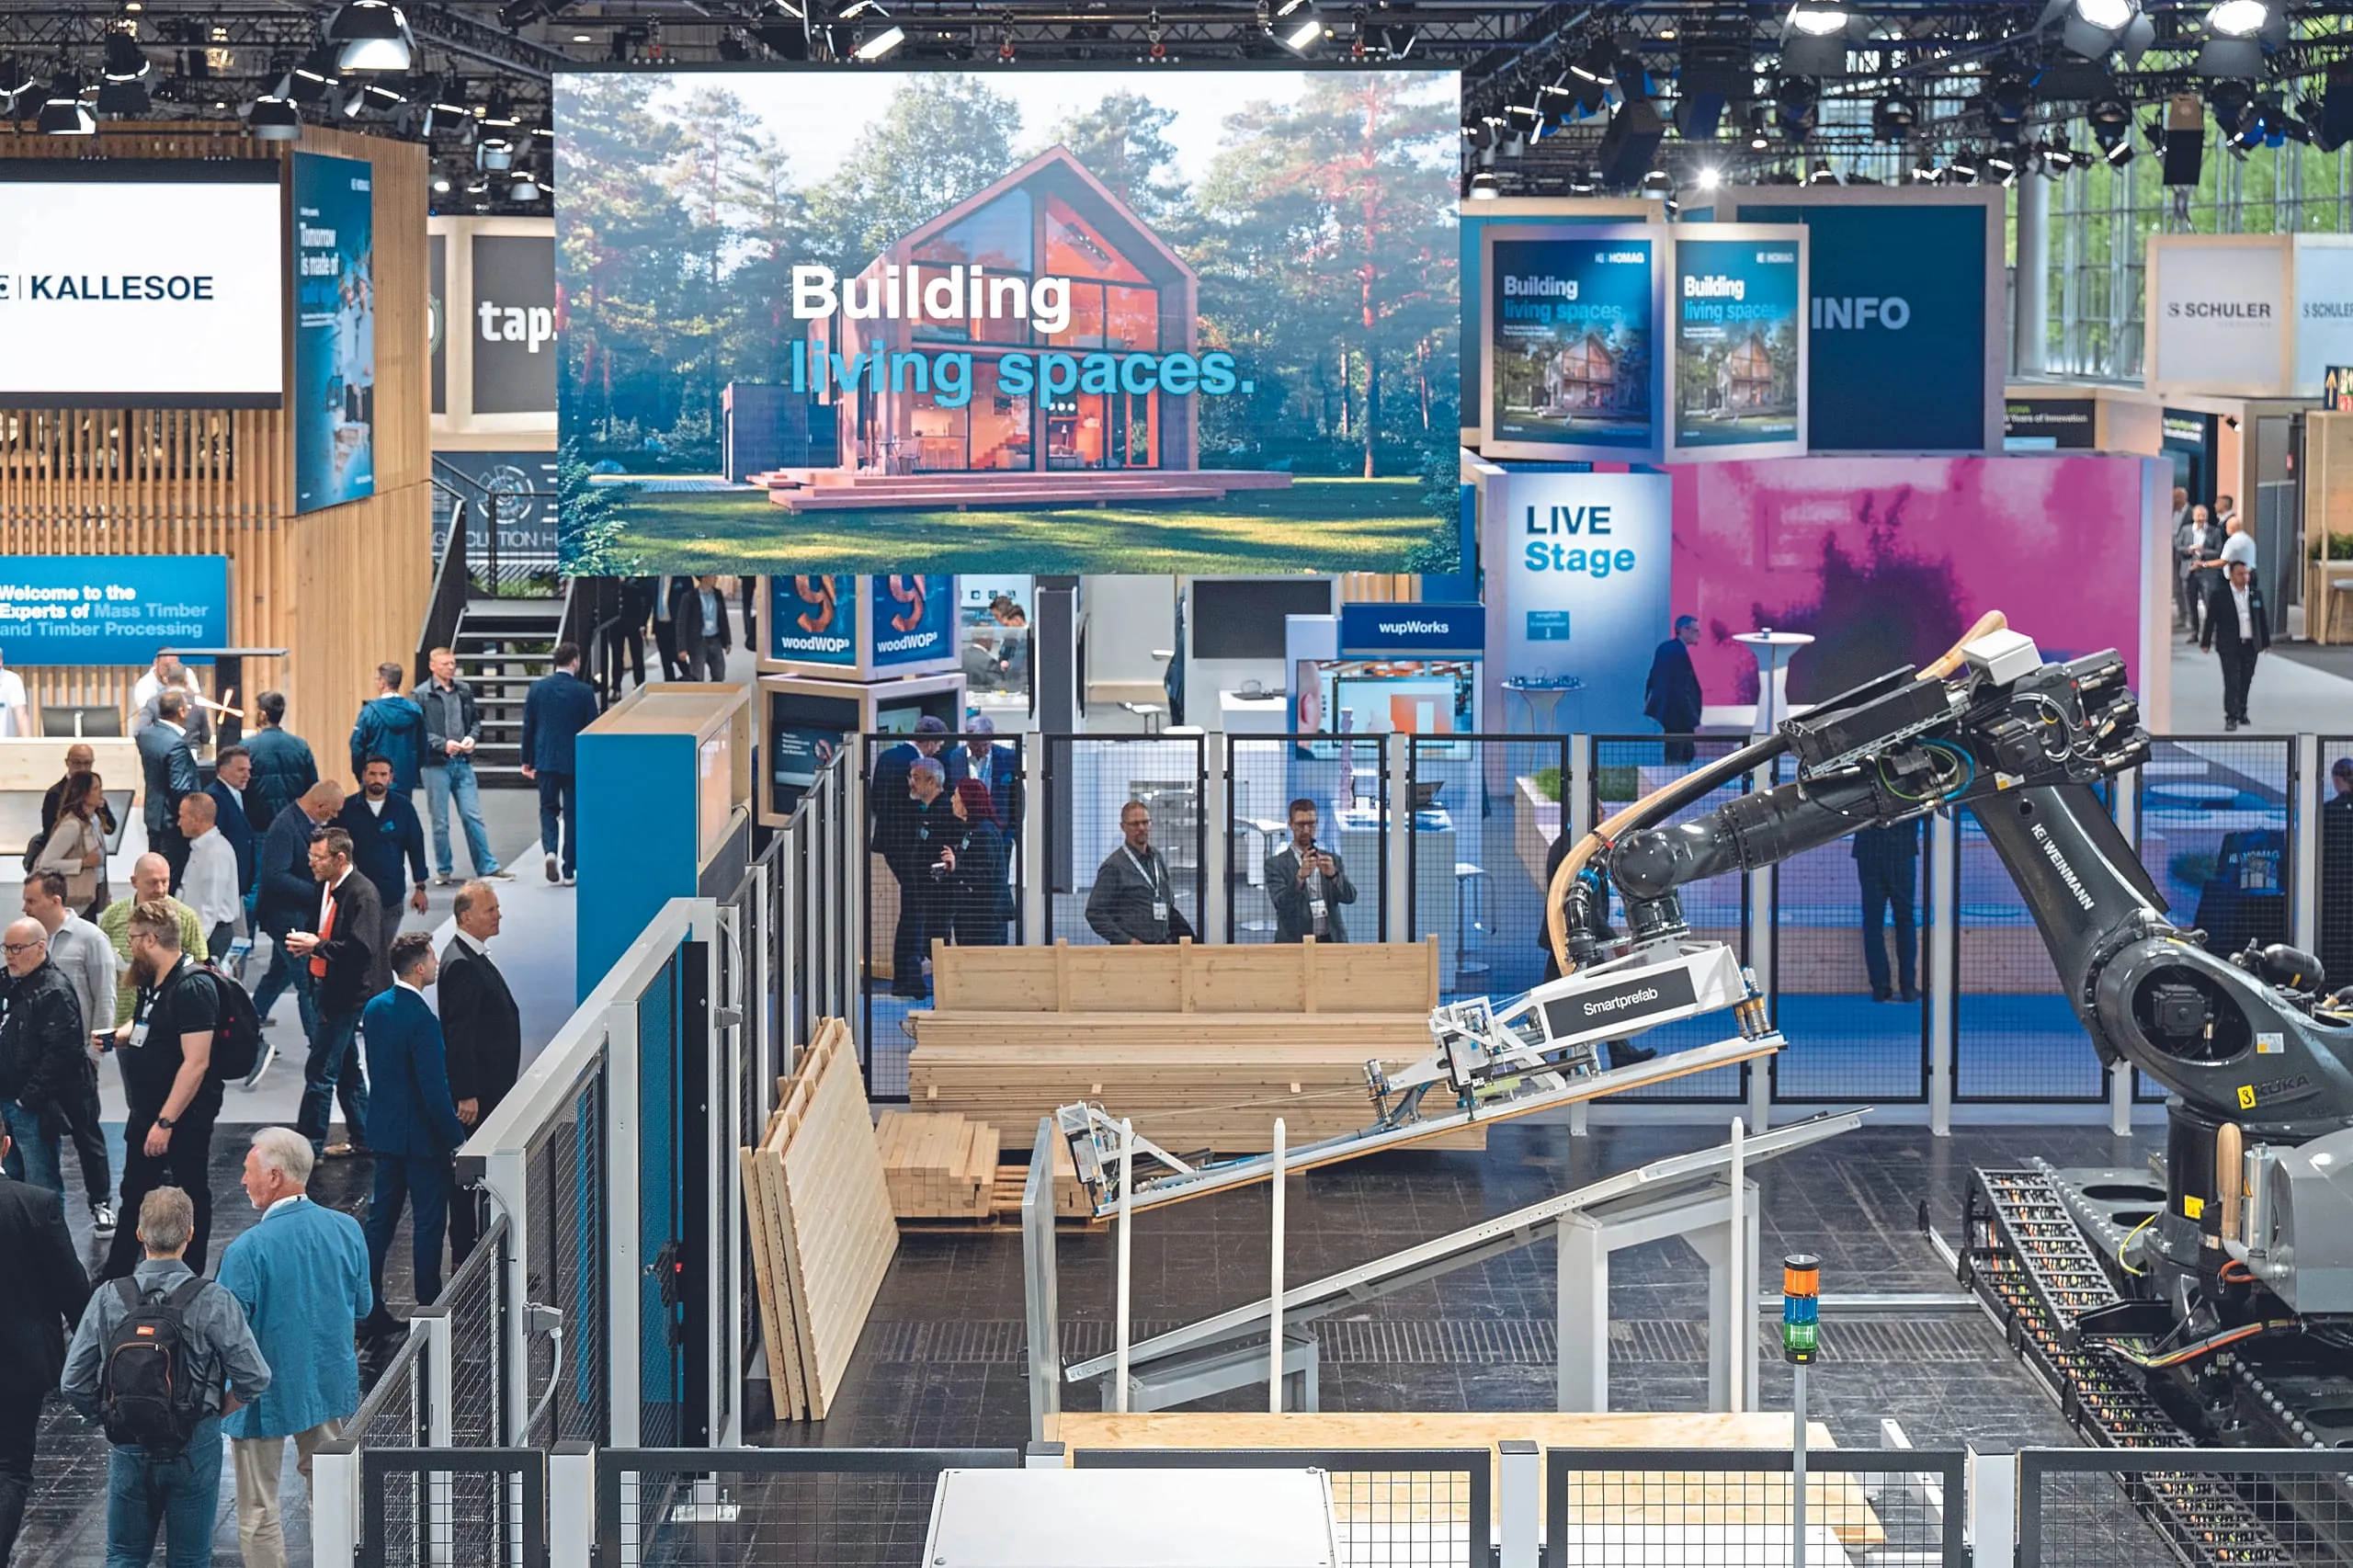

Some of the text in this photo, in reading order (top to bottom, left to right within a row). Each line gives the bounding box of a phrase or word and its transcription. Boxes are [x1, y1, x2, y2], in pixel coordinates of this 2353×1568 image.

[30, 275, 214, 301] KALLESOE
[791, 265, 1072, 334] Building
[1504, 276, 1578, 301] Building
[1684, 275, 1745, 301] Building
[1505, 300, 1552, 322] living
[1684, 301, 1723, 324] living
[1812, 296, 1911, 330] INFO
[2185, 302, 2271, 319] SCHULER
[791, 340, 1256, 408] living spaces.
[1528, 506, 1611, 535] LIVE
[1525, 540, 1635, 578] Stage
[0, 585, 136, 600] Welcome to the
[0, 603, 209, 621] Experts of Mass Timber
[0, 621, 202, 638] and Timber Processing
[1379, 620, 1449, 636] wupWorks
[2043, 840, 2095, 911] WEINMANN
[1584, 987, 1658, 1016] Smartprefab
[2256, 1074, 2310, 1097] KUKA
